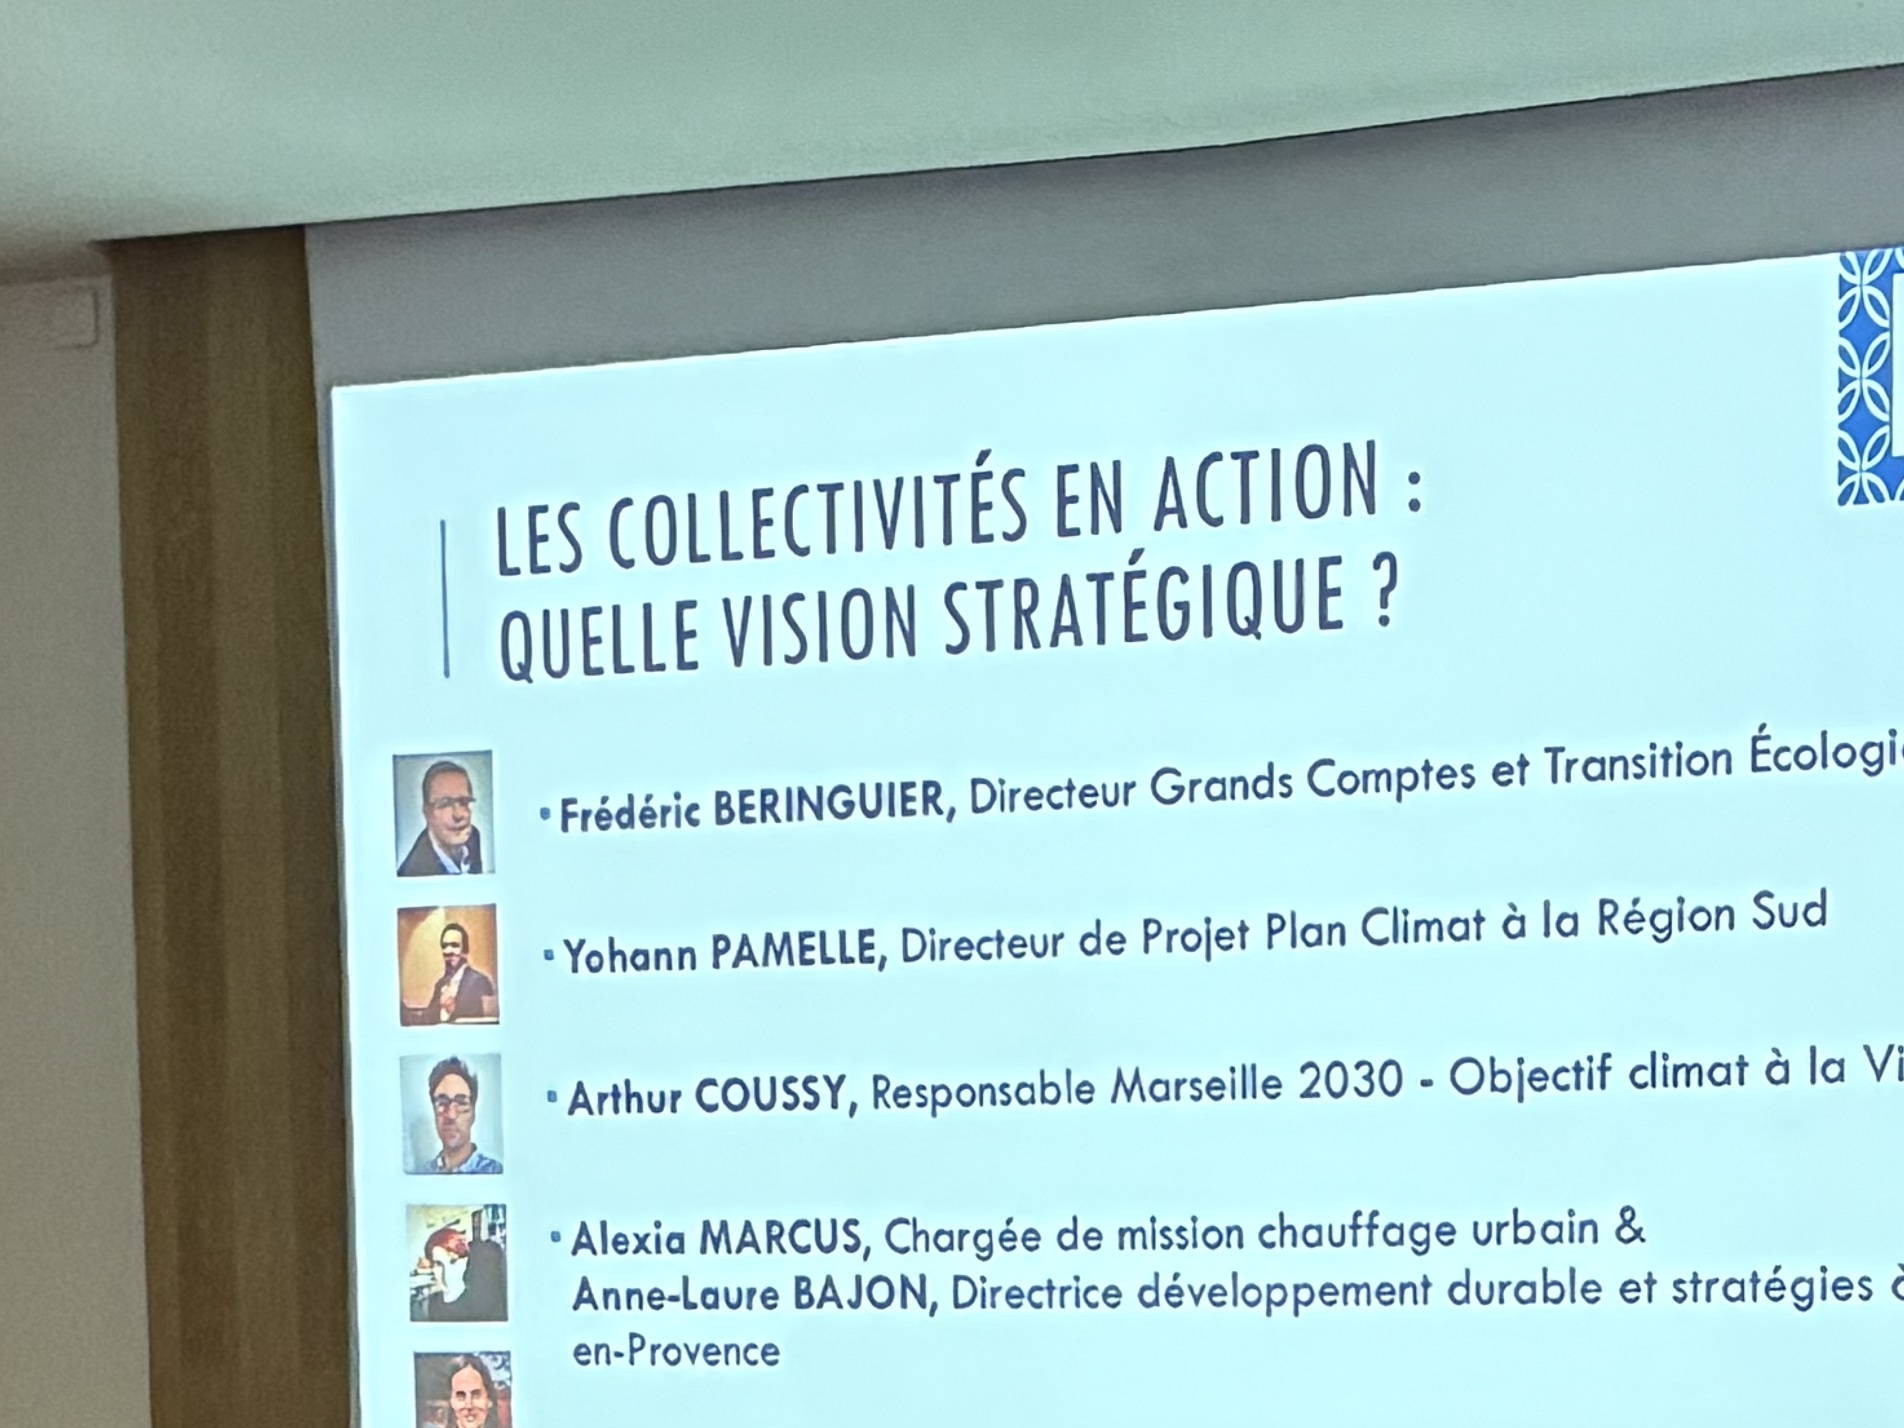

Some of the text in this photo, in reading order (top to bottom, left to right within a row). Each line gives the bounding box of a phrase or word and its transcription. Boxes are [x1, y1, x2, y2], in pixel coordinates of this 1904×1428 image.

[496, 500, 584, 578] LES
[608, 448, 1029, 571] COLLECTIVITÉS
[1055, 458, 1124, 539] EN
[1152, 438, 1377, 533] ACTION
[499, 549, 1399, 686] QUELLE VISION STRATÉGIQUE ?
[559, 789, 702, 835] Frédéric
[713, 778, 958, 827] BERINGUIER,
[969, 776, 1138, 816] Directeur
[1149, 759, 1295, 807] Grands
[1305, 756, 1477, 805] Comptes
[1490, 751, 1532, 789] et
[1542, 739, 1734, 786] Transition
[561, 885, 1828, 975] Yohann PAMELLE, Directeur de Projet Plan Climat à la Région Sud
[566, 1077, 684, 1118] Arthur
[693, 1072, 859, 1120] COUSSY,
[871, 1066, 1097, 1120] Responsable
[1109, 1061, 1284, 1105] Marseille
[1298, 1057, 1404, 1101] 2030
[1448, 1050, 1614, 1103] Objectif
[1627, 1048, 1751, 1091] climat
[1763, 1045, 1791, 1087] à
[1808, 1043, 1847, 1087] la
[569, 1203, 1648, 1264] Alexia MARCUS, Chargée de mission chauffage urbain &
[570, 1273, 781, 1313] Anne-Laure
[793, 1272, 940, 1319] BAJON,
[951, 1273, 1124, 1311] Directrice
[1136, 1269, 1434, 1319] développement
[1446, 1264, 1604, 1307] durable
[1617, 1269, 1659, 1306] et
[1670, 1263, 1875, 1314] stratégies
[571, 1330, 782, 1368] en-Provence
